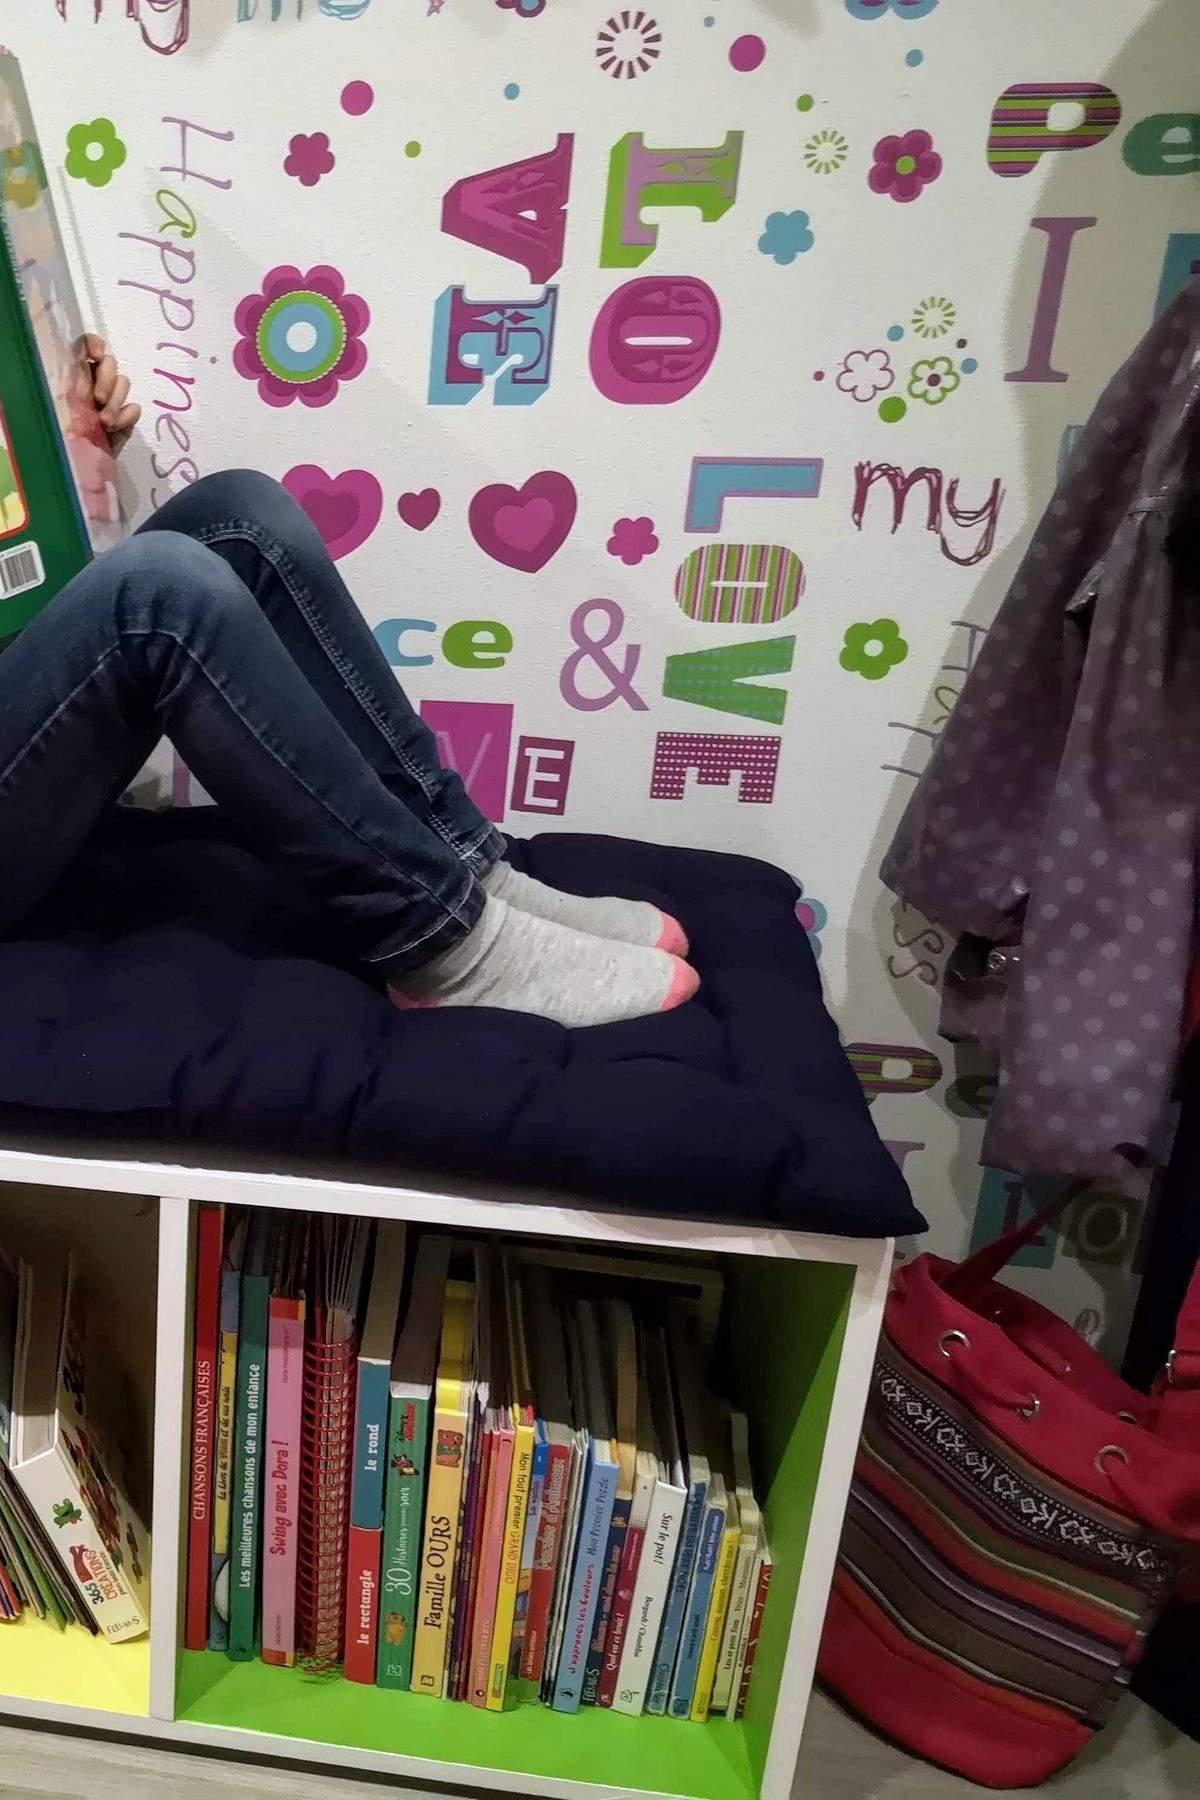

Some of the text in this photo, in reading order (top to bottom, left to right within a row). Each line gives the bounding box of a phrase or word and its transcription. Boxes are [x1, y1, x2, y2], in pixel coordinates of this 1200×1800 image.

[118, 116, 234, 511] Happines
[852, 461, 1005, 566] my
[193, 1361, 210, 1520] CHANSONS FRANÇAISES
[364, 1424, 379, 1471] le rond
[519, 1452, 530, 1471] Mon
[239, 1364, 260, 1587] Les meilleures chansons de mon enfance
[516, 1474, 528, 1493] tout
[528, 1479, 539, 1516] La vache
[269, 1449, 292, 1555] Swing avec Dora
[512, 1495, 523, 1529] premier
[660, 1513, 673, 1530] Sur
[392, 1528, 408, 1567] Histoires
[508, 1531, 520, 1561] GRAND
[658, 1532, 670, 1542] le
[85, 1550, 118, 1600] CRÉATIONS
[86, 1583, 104, 1605] 365
[386, 1568, 411, 1595] 30
[424, 1516, 451, 1628] Famille OURS
[568, 1478, 609, 1674] J'apprends les Couleurs Mon Premier Puzzle
[356, 1570, 374, 1645] le rectangle
[606, 1653, 617, 1671] Quel
[612, 1618, 623, 1635] bruit
